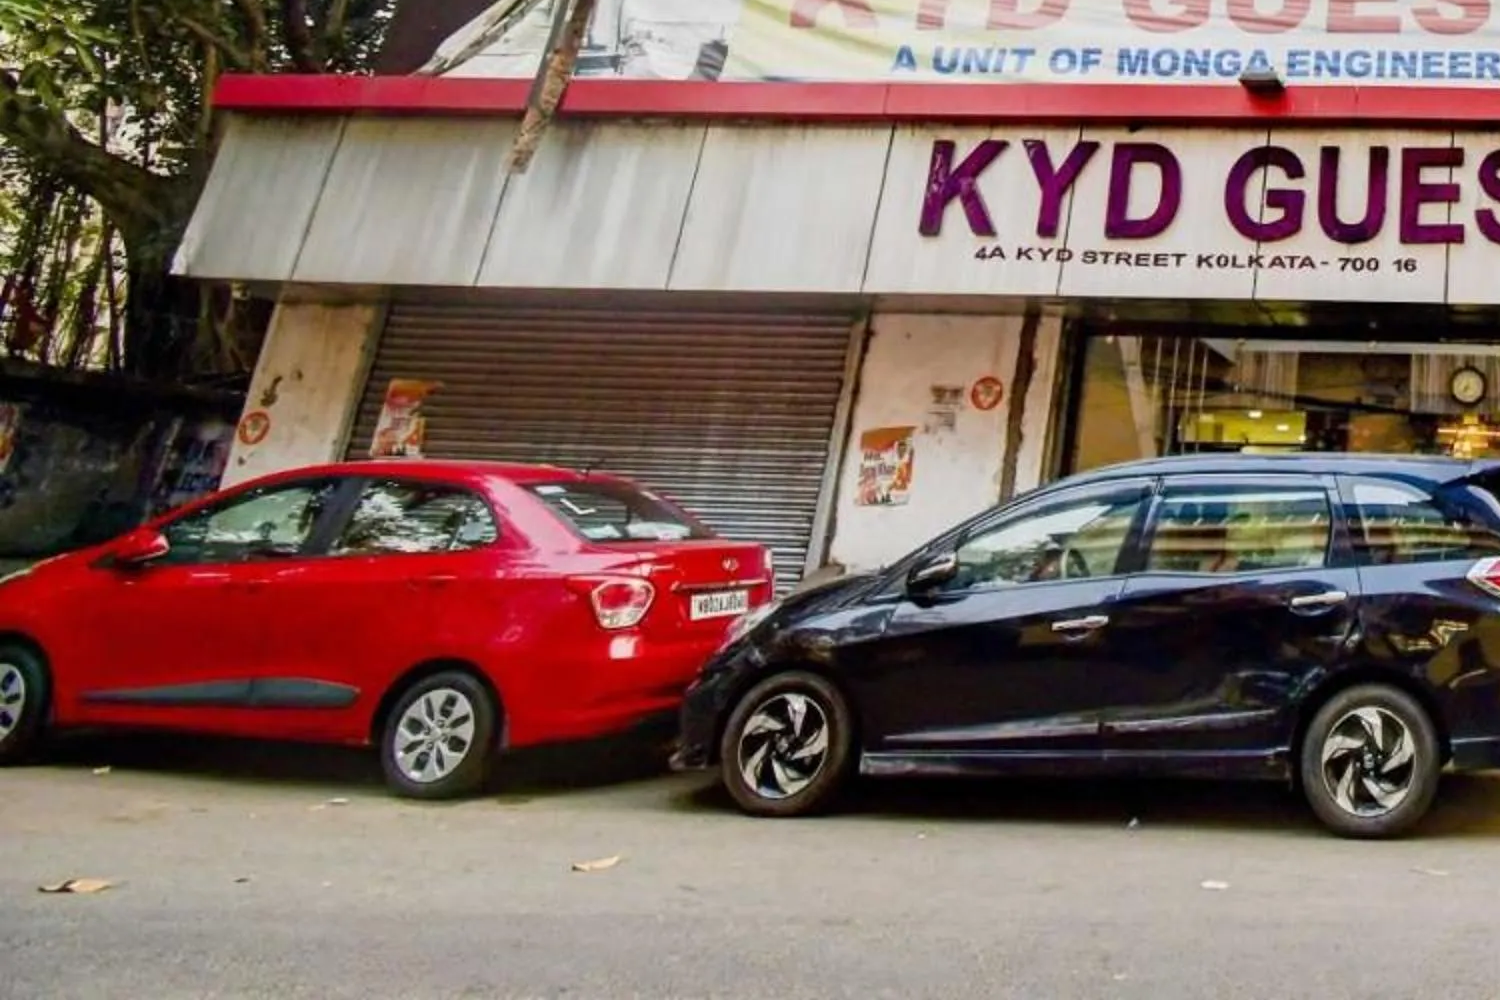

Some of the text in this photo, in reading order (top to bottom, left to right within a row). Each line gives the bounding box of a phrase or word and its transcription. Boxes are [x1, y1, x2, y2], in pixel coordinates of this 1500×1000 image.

[894, 47, 916, 73] A
[932, 48, 1032, 75] UNIT
[1050, 48, 1101, 76] OF
[1117, 48, 1275, 79] MONGA
[917, 138, 1184, 239] KYD
[974, 247, 1006, 261] 4A
[1016, 247, 1073, 263] KYD
[1081, 251, 1188, 269] STREET
[1338, 256, 1380, 273] 700
[1392, 258, 1418, 274] 16
